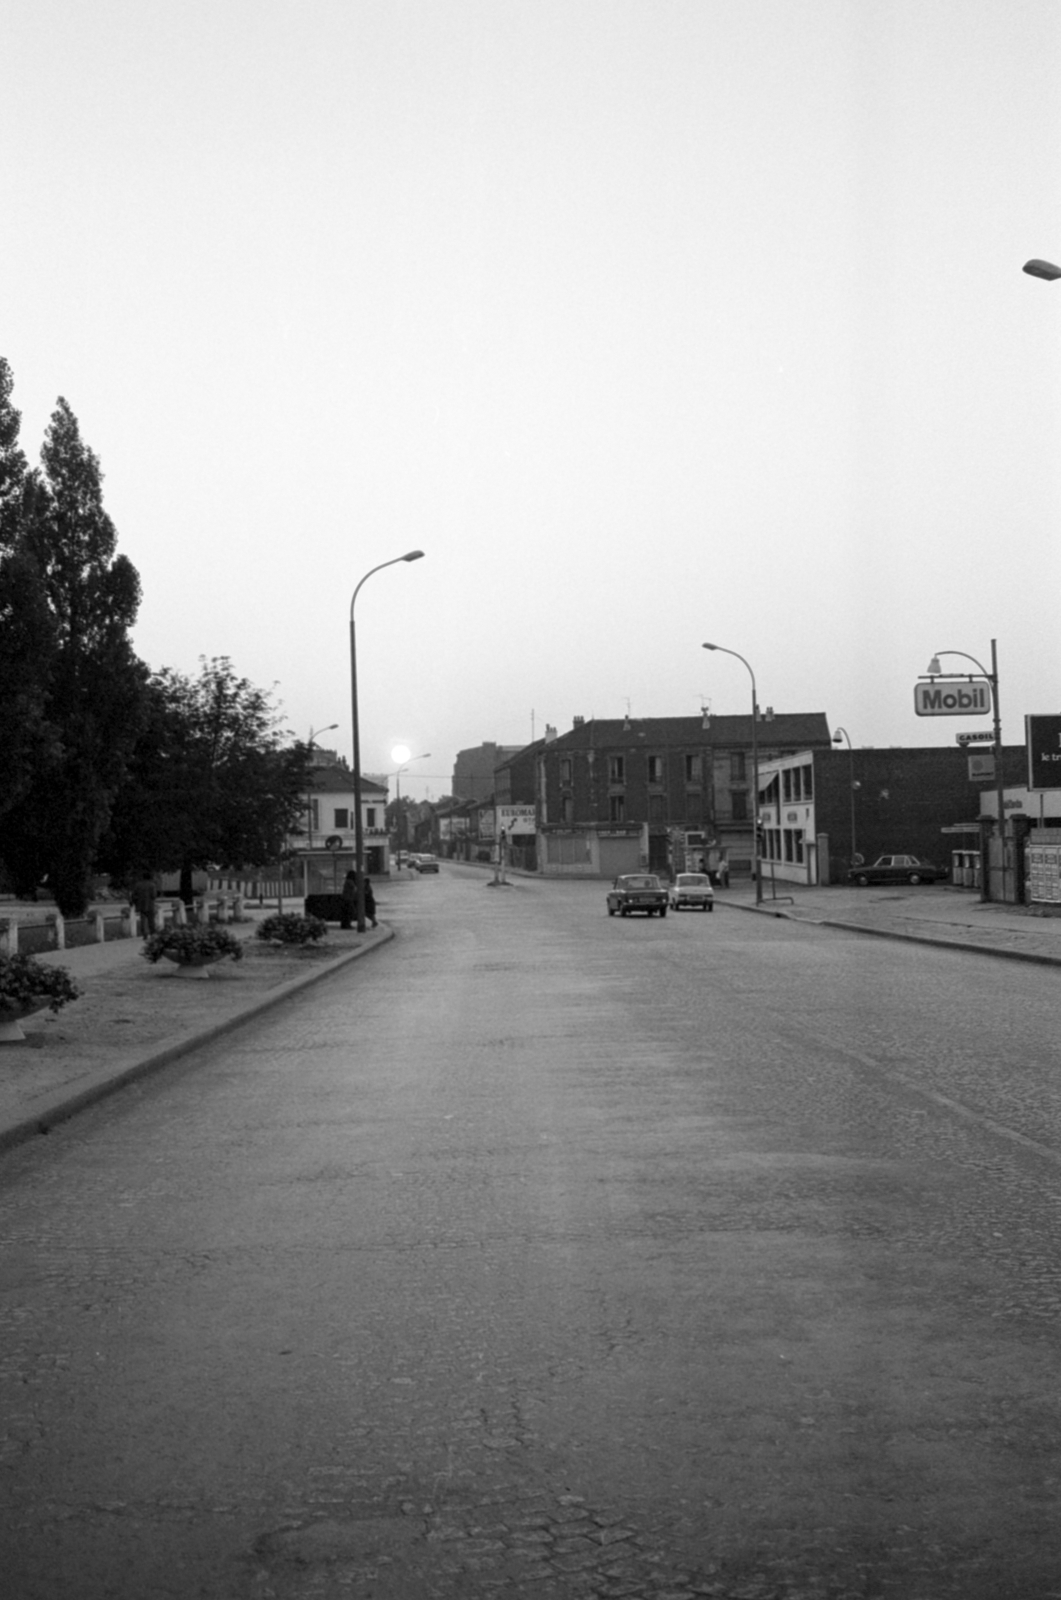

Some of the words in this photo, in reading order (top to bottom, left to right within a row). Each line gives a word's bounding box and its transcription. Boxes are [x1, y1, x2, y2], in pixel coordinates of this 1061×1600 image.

[922, 688, 985, 709] Mobil
[959, 733, 994, 741] GASOIL
[1052, 753, 1061, 761] tr
